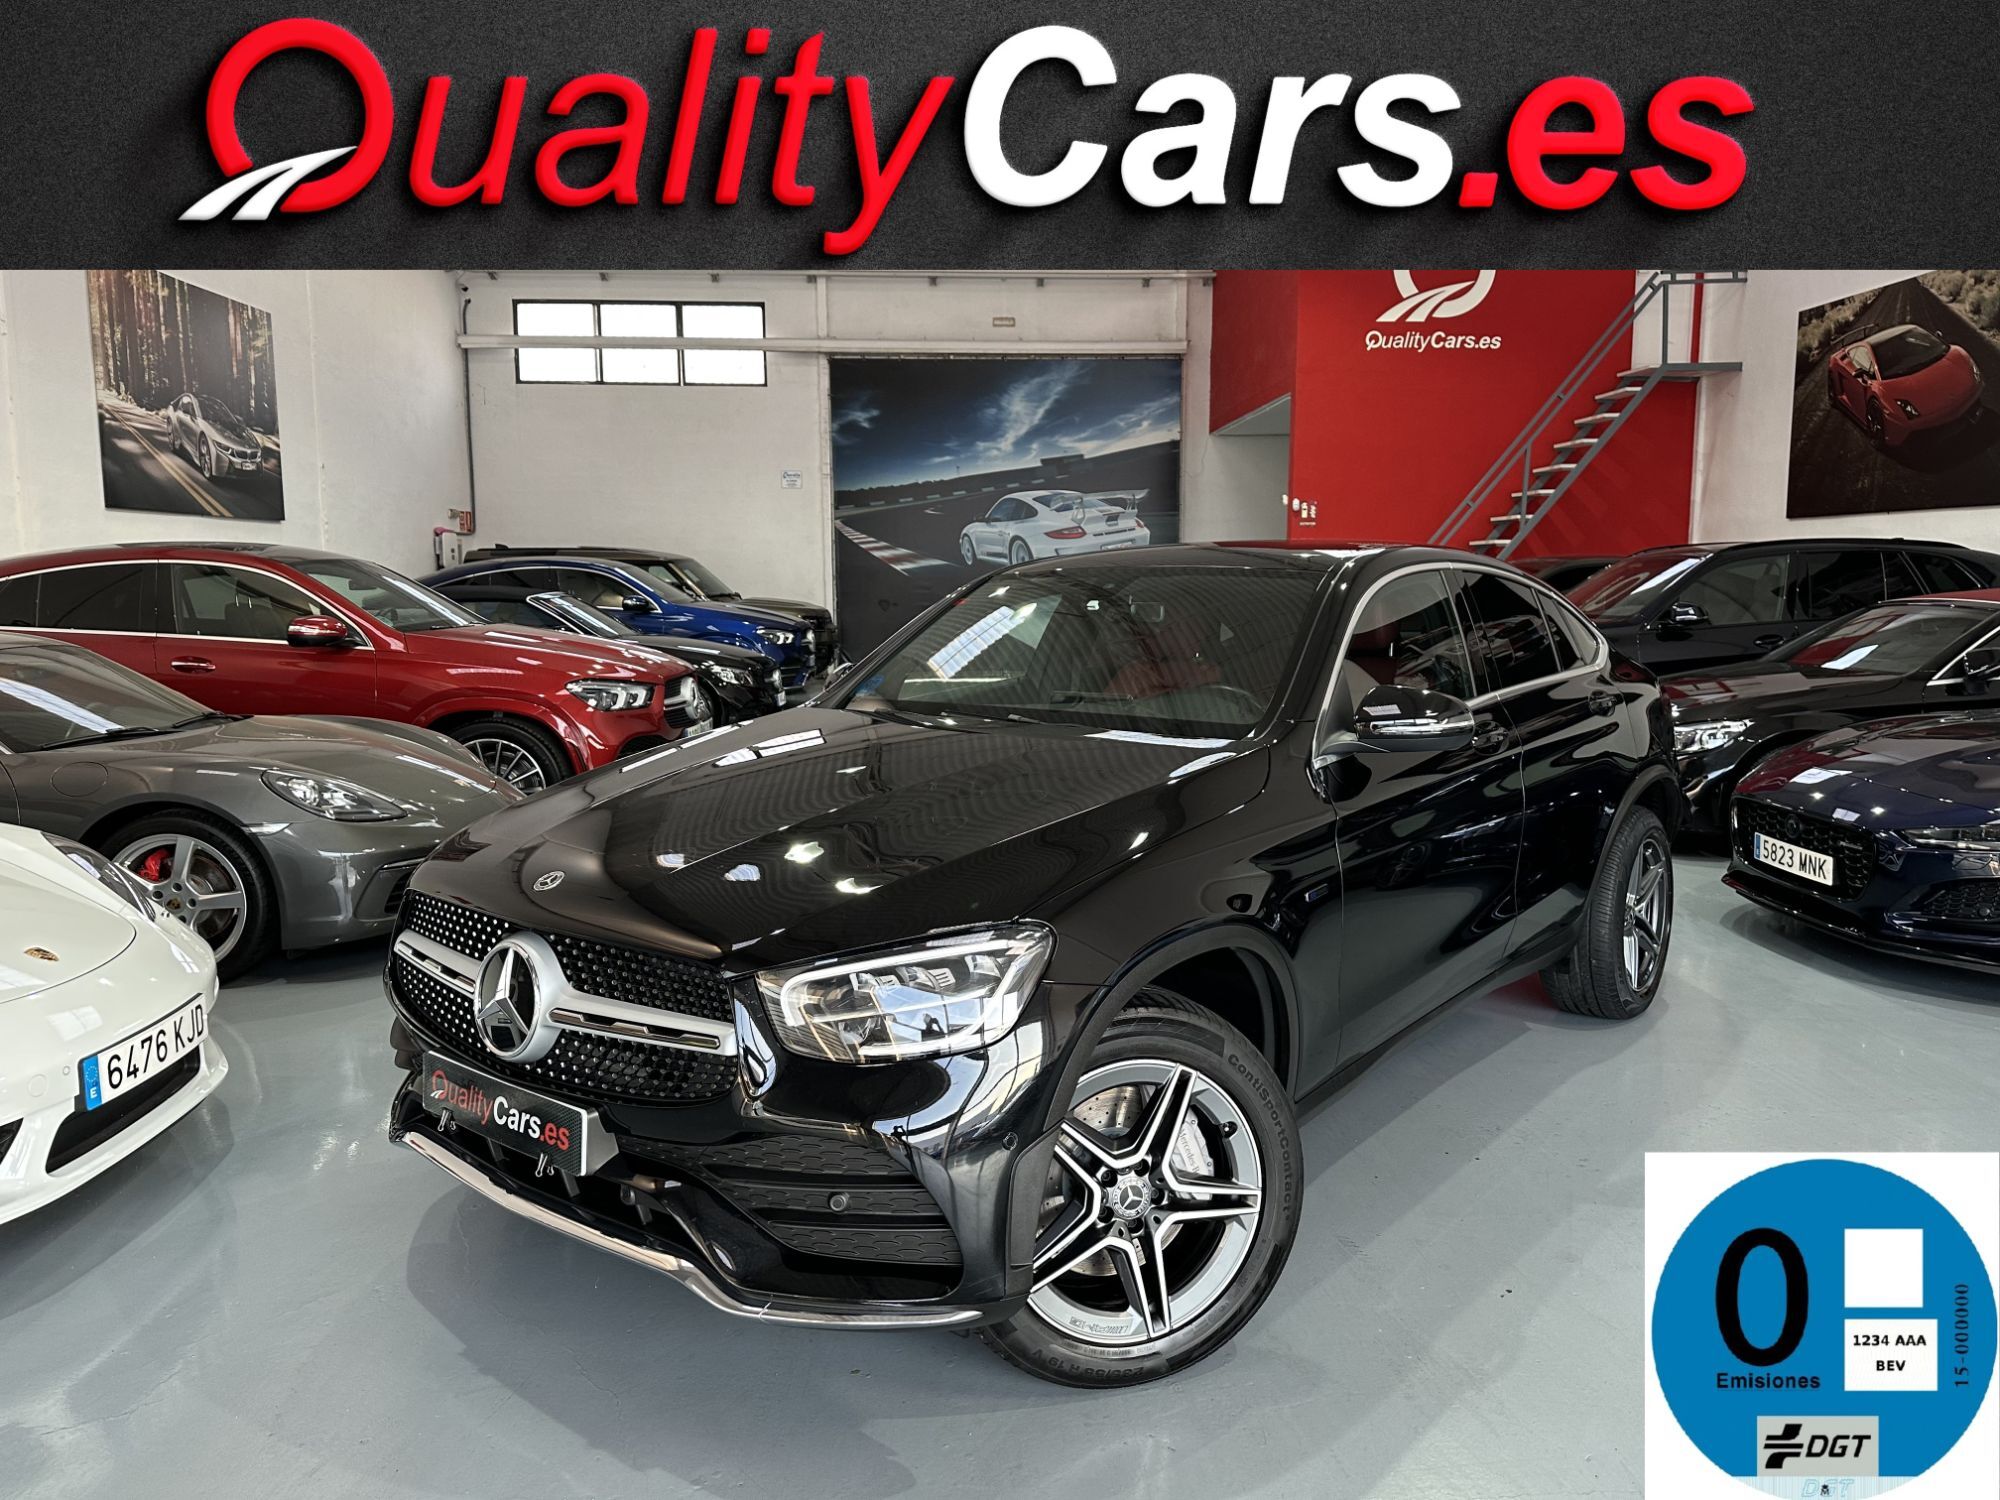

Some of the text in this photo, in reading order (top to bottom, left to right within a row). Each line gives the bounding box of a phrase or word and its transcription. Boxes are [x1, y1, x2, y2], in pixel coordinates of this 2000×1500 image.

[1365, 330, 1502, 352] QualityCars.es
[1763, 839, 1827, 880] 5823 MNK
[106, 1003, 205, 1090] 6476 KJD
[431, 1069, 571, 1151] QualityCars.es
